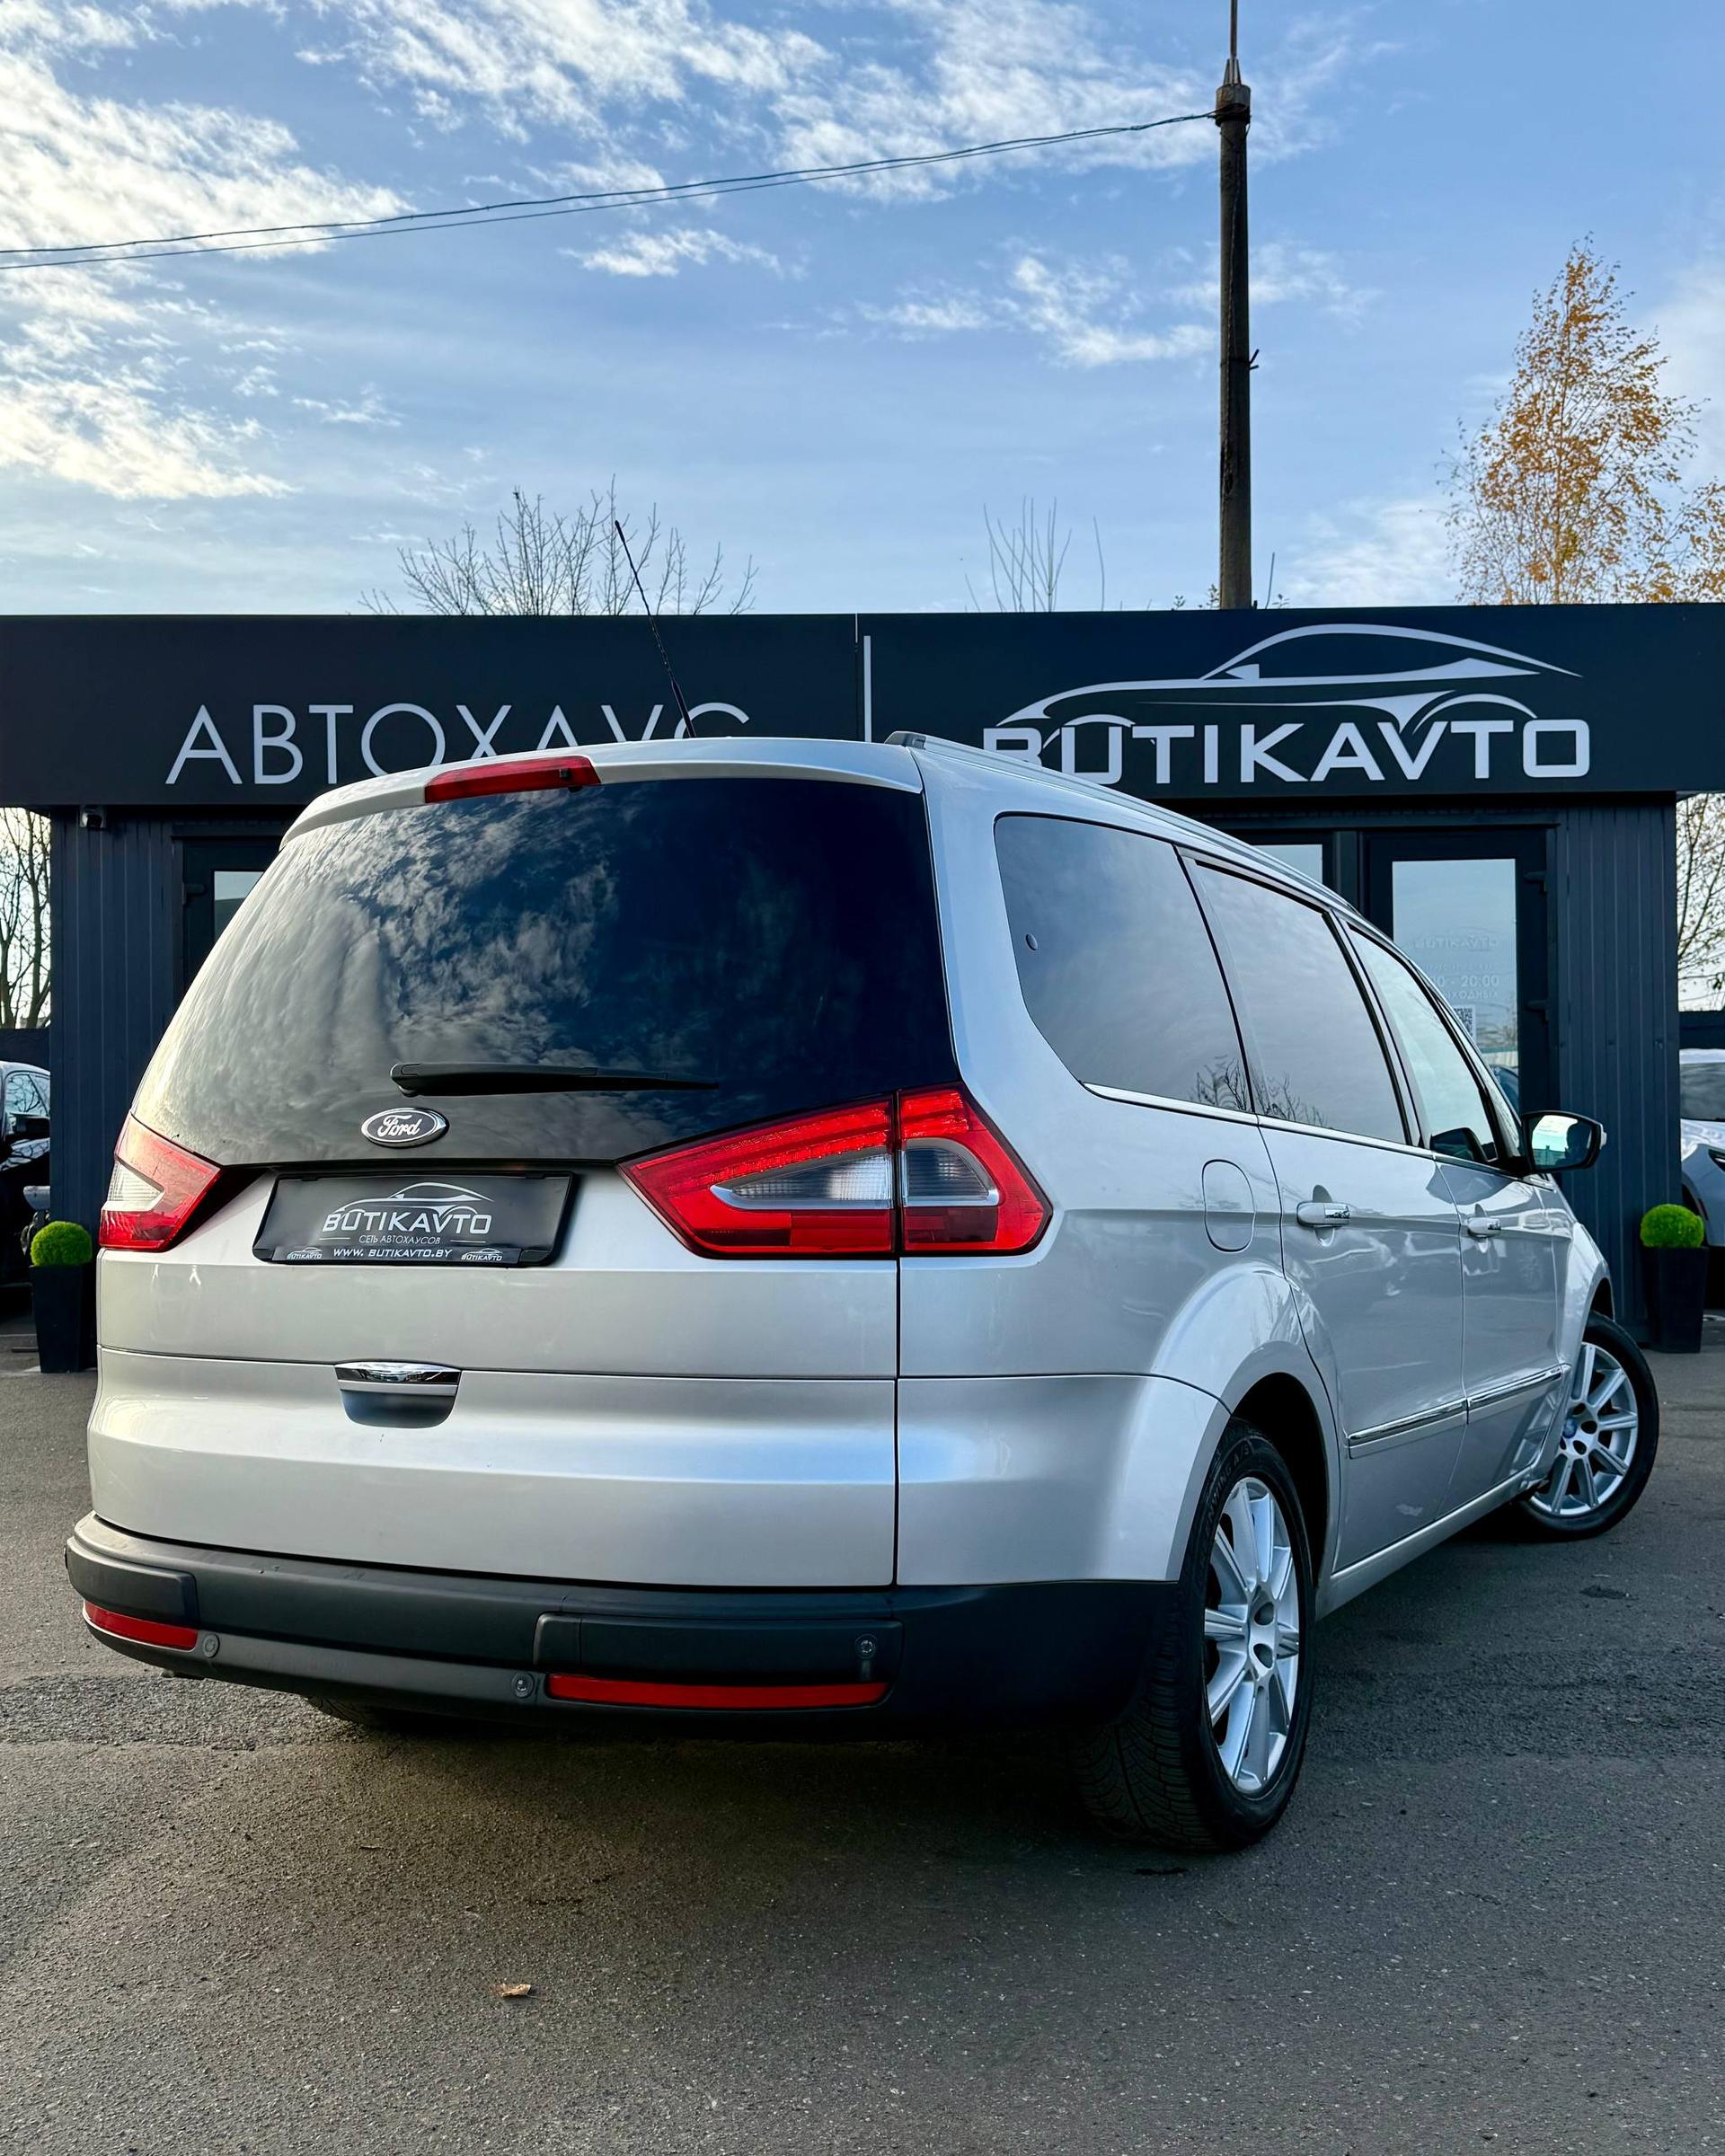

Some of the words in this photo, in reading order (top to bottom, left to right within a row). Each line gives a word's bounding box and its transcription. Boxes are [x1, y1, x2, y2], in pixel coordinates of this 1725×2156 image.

[984, 719, 1590, 783] BUTIKAVTO
[1461, 975, 1499, 987] 20:00
[1446, 990, 1499, 1000] ЫХОДНЫХ
[377, 1114, 420, 1137] Ford
[323, 1212, 492, 1234] BUTIKAVTO
[359, 1234, 379, 1244] СЕТЬ
[379, 1235, 442, 1245] АВТОХАУСОВ
[287, 1252, 323, 1260] BUTIKAVTO
[333, 1248, 364, 1258] WWW.
[367, 1248, 453, 1259] BUTIKAVTO.BY
[461, 1253, 503, 1261] BUTIKAVTO
